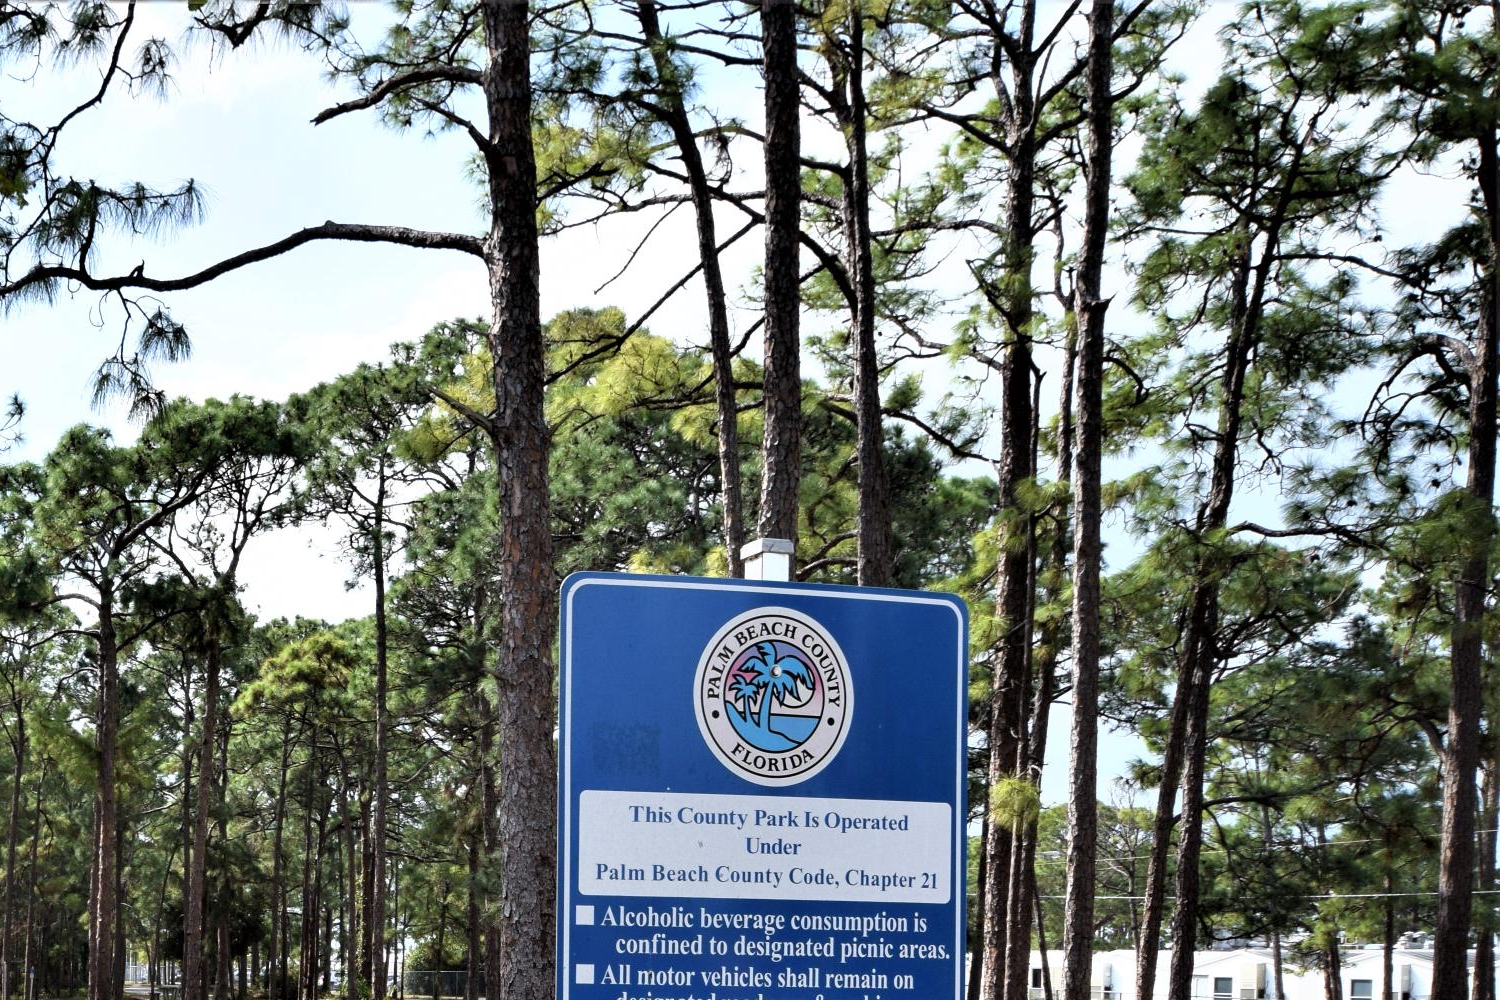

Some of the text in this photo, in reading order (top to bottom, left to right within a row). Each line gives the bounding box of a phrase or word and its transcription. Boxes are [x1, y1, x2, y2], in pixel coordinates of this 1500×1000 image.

[706, 621, 842, 708] PALM BEACH COUNTY
[730, 741, 816, 773] FLORIDA
[629, 806, 908, 833] This County Park Is Operated
[747, 838, 801, 855] Under
[596, 864, 936, 891] Palm Beach County Code, Chapter 21
[601, 906, 926, 938] Alcoholic beverage consumption is
[616, 934, 949, 963] confined to designated picnic areas.
[601, 964, 913, 989] All motor vehicles shall remain on
